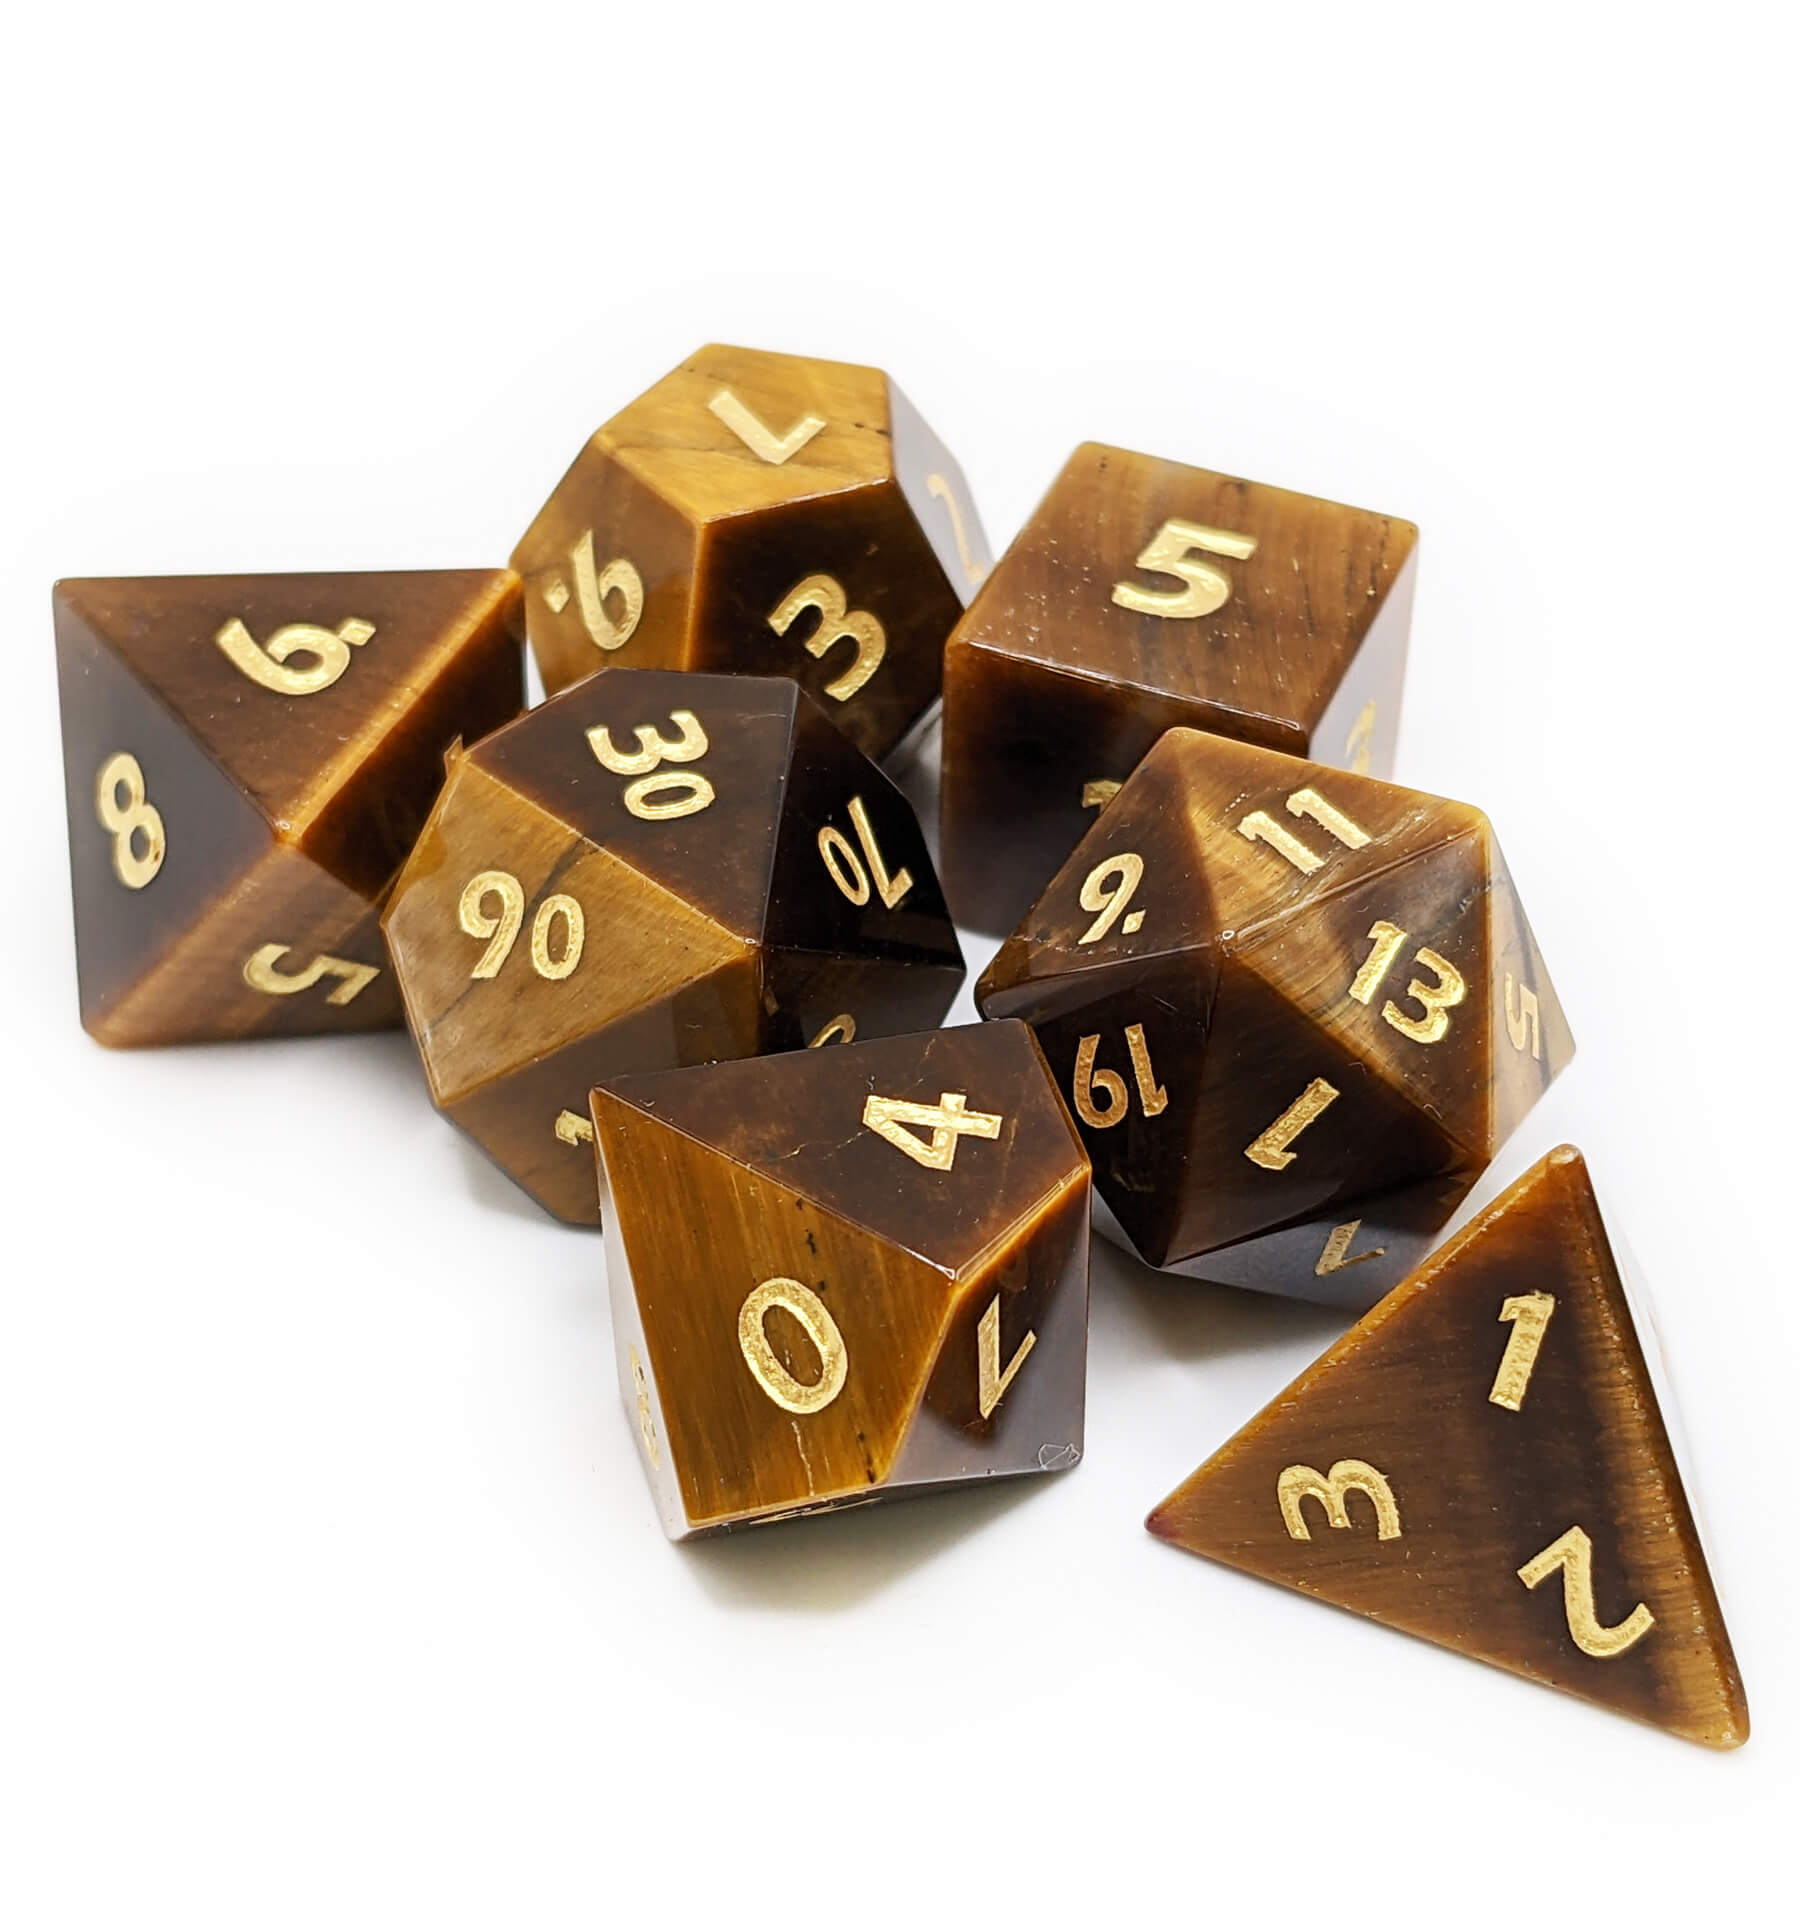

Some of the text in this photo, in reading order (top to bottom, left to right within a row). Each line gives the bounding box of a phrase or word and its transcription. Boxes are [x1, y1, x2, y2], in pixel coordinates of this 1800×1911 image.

[709, 389, 826, 466] 7
[1111, 516, 1258, 619] 5
[767, 573, 887, 702] 3
[586, 709, 716, 821] 30
[98, 752, 167, 890] 8
[817, 795, 913, 910] 70
[1236, 787, 1372, 875] 11
[242, 943, 381, 1006] 5
[458, 869, 586, 981] 90
[1346, 919, 1467, 1044] 13
[1503, 971, 1540, 1061] 5
[1072, 1022, 1169, 1130] 19
[1243, 1076, 1341, 1171] 1
[862, 1091, 1003, 1172] 4
[737, 1276, 849, 1416] 0
[1488, 1289, 1556, 1413] 1
[1276, 1457, 1402, 1541] 3
[1516, 1524, 1656, 1658] 2
